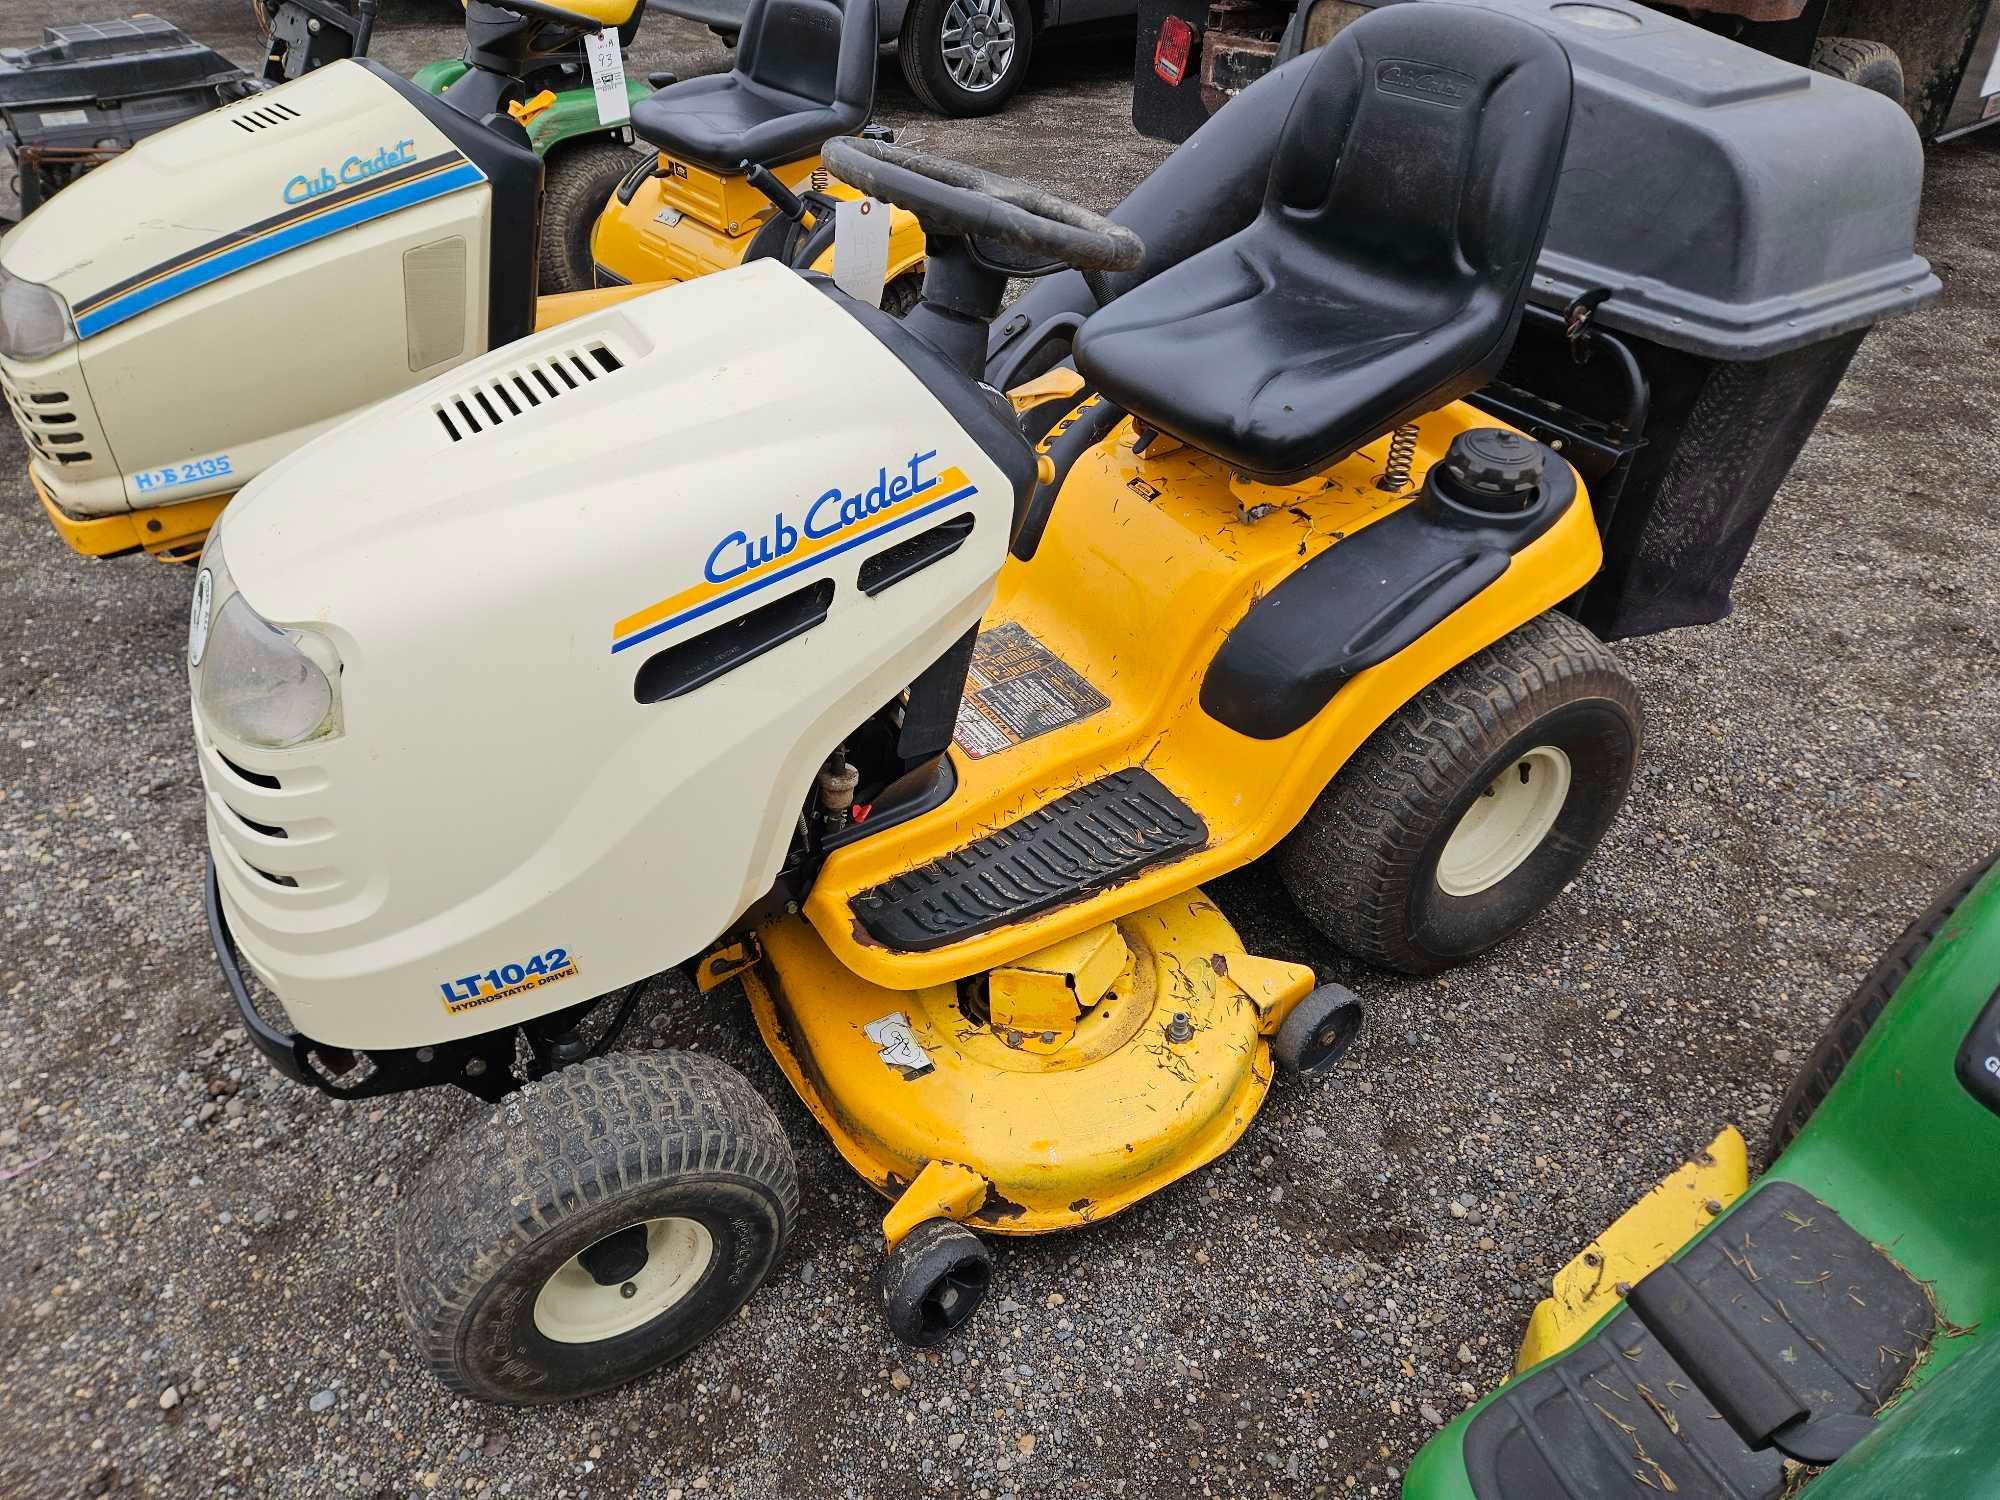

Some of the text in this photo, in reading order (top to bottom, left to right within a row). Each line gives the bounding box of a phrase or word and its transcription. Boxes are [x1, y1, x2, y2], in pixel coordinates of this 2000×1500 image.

[283, 137, 417, 204] Cub Cadet
[181, 454, 230, 479] 2135
[704, 449, 937, 583] Cub Cadet
[440, 948, 571, 1004] LT1042
[451, 968, 575, 1013] HYDROSTATIC DRIVE
